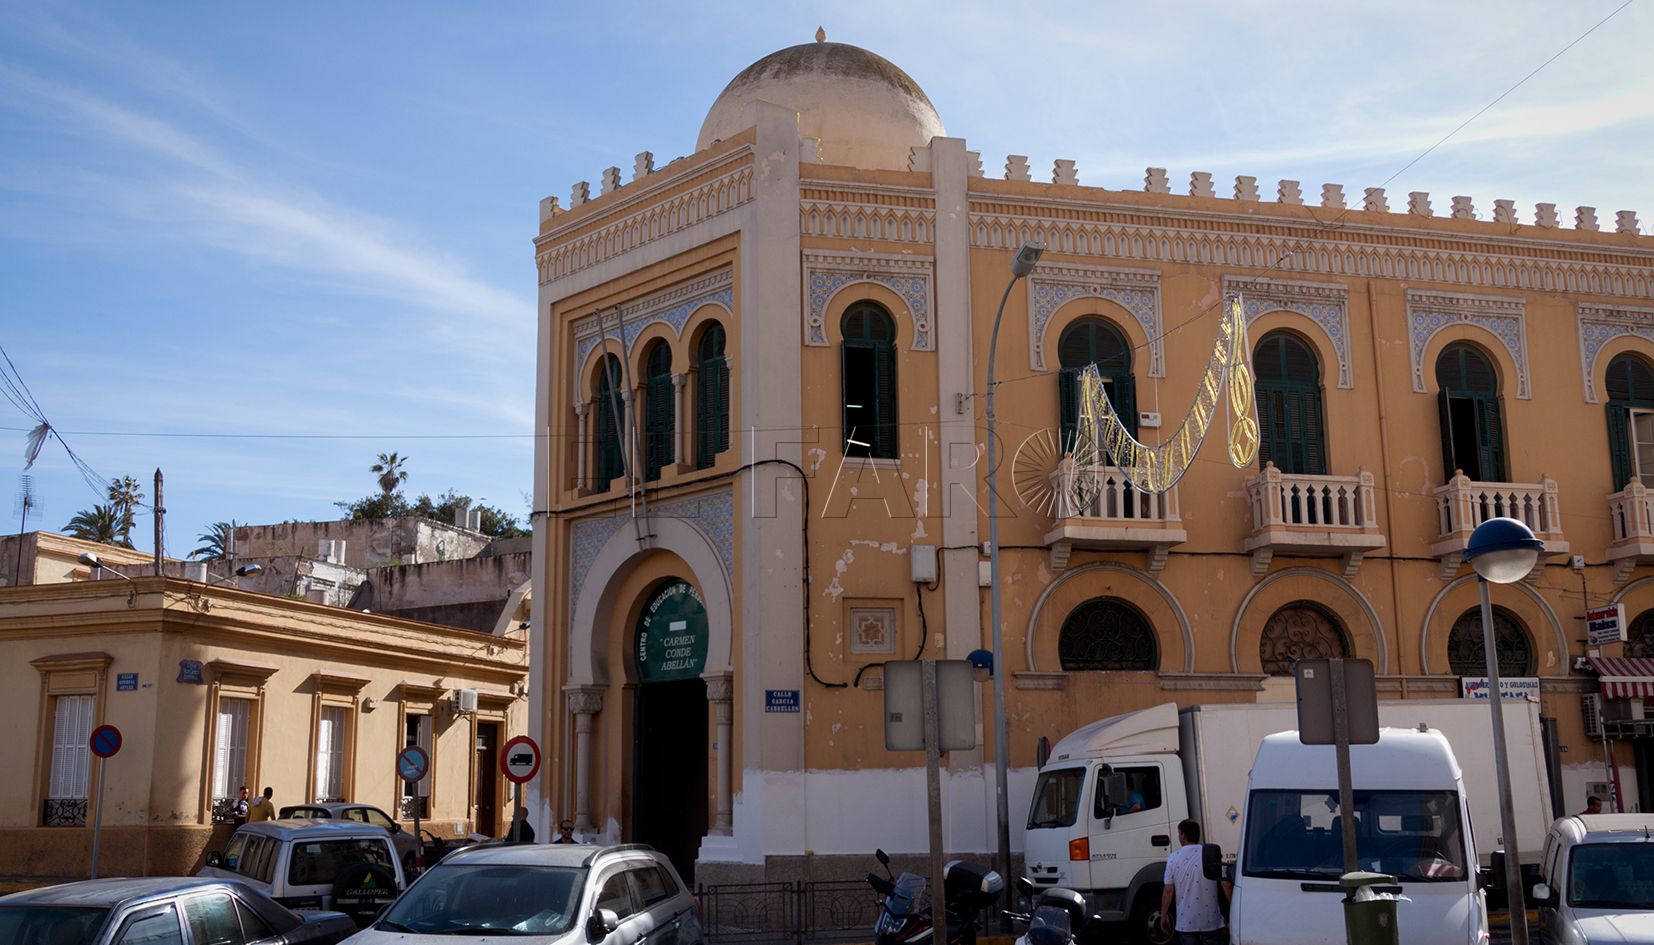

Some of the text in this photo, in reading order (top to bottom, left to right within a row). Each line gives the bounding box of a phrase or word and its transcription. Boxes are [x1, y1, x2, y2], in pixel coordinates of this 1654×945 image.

[679, 584, 687, 593] DE
[643, 616, 652, 627] DE
[640, 632, 648, 661] CENTRO
[665, 647, 692, 659] CONDE
[1505, 681, 1509, 689] Y
[346, 888, 389, 896] GALLOPER
